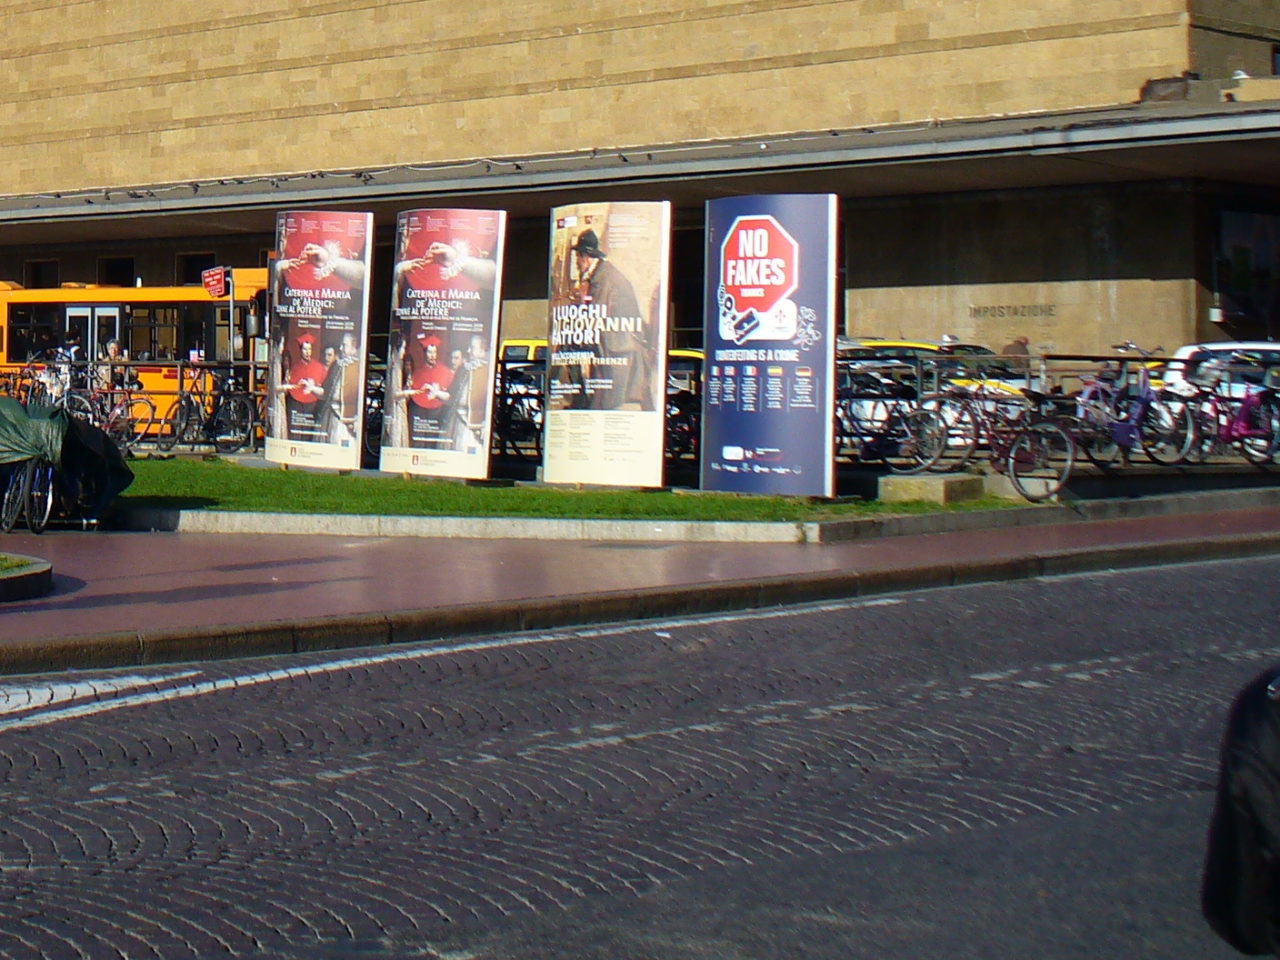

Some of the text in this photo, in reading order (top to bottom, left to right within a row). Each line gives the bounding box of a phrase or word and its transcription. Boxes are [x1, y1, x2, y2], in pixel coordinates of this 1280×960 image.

[738, 228, 768, 258] NO
[727, 258, 786, 286] FAKES
[284, 287, 352, 300] CATERINA E MARIA
[406, 288, 481, 300] CATERINA E MARIA
[296, 305, 322, 315] POTERE
[427, 298, 463, 309] MEDICI:
[420, 307, 449, 316] POTERE
[557, 304, 608, 320] LUOGHI
[563, 317, 642, 332] GIOVANNI
[551, 330, 601, 345] FATTORI
[592, 357, 628, 366] FIRENZE
